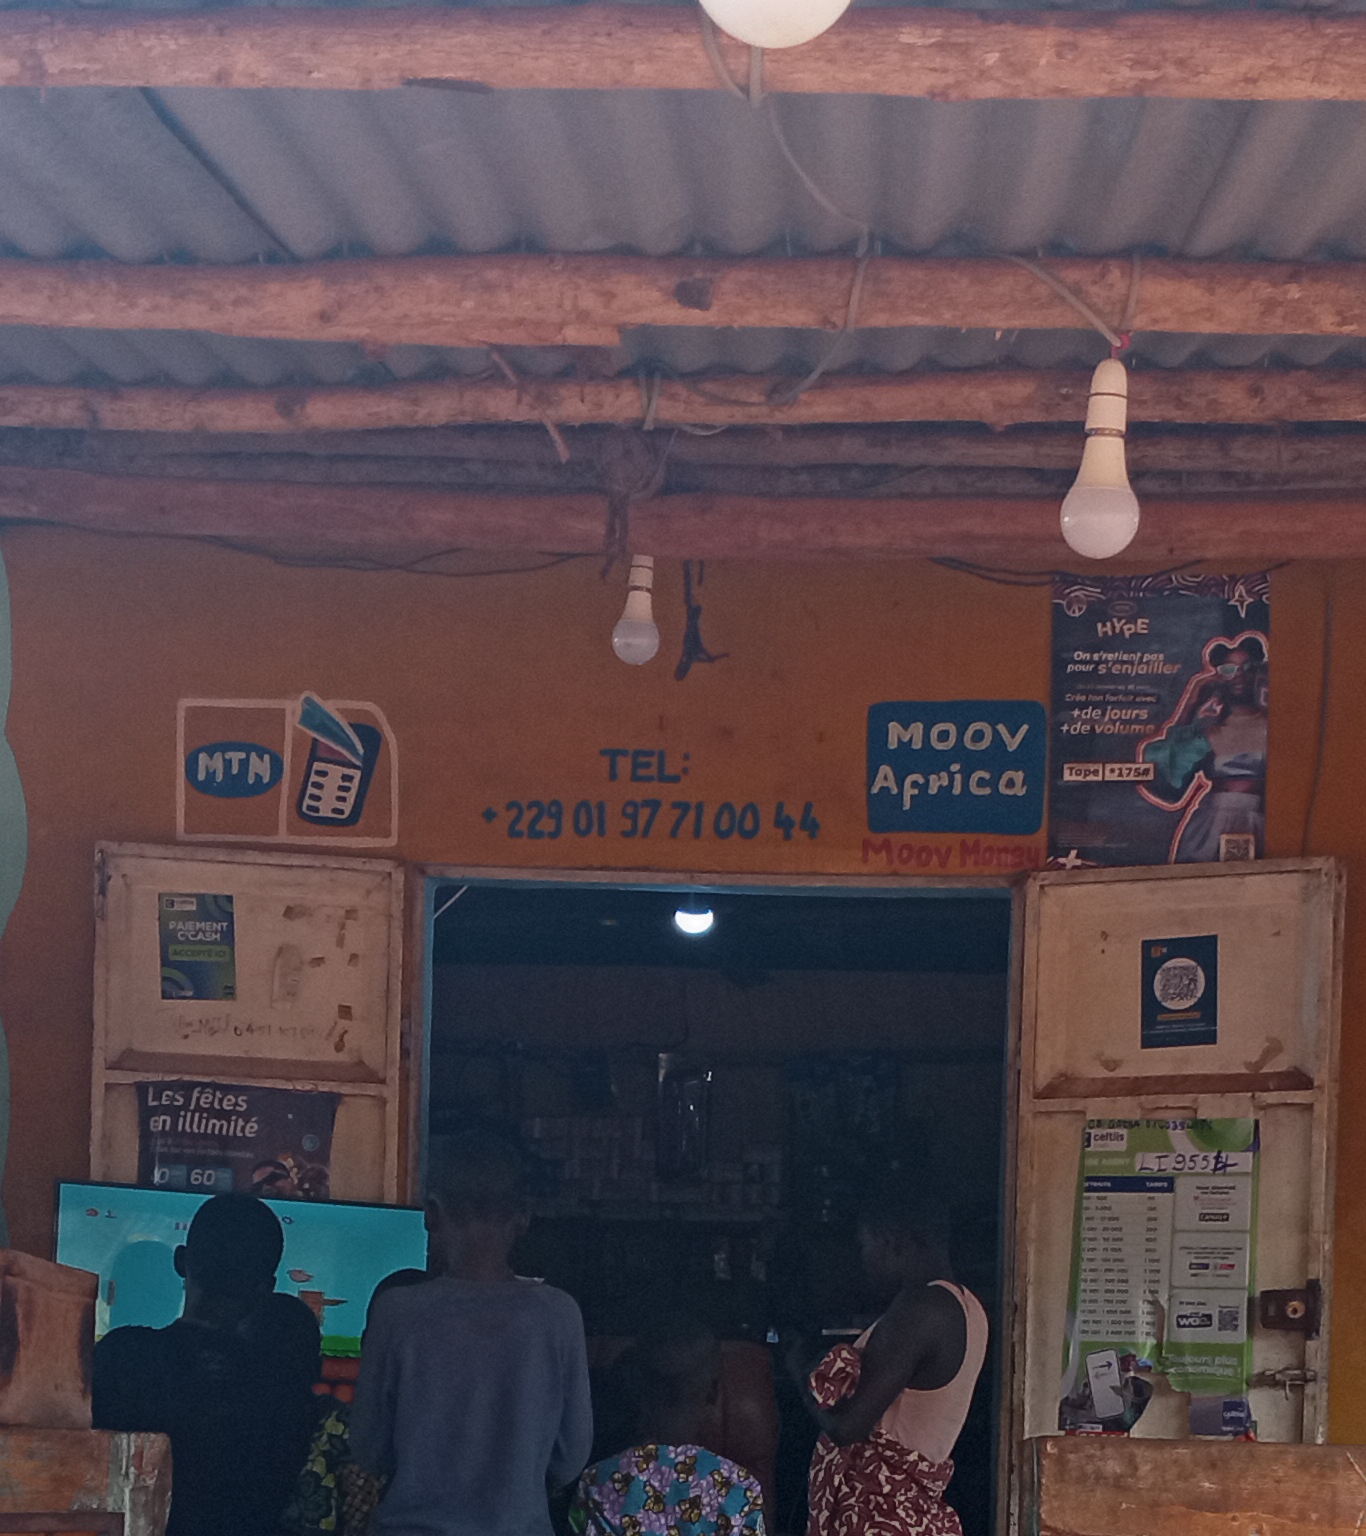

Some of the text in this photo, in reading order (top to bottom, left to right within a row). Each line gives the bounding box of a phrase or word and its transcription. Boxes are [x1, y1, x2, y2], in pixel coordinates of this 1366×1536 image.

[1074, 651, 1090, 661] On
[1066, 661, 1182, 677] pour s'enjailler
[1104, 706, 1149, 722] jours
[887, 721, 1030, 752] MOOV
[1095, 722, 1156, 735] volume
[197, 751, 271, 785] MTN
[599, 748, 690, 783] TEL:
[1066, 766, 1100, 779] Tape
[870, 763, 1027, 810] Africa
[573, 801, 606, 838] 01
[620, 799, 662, 839] 97
[670, 801, 704, 839] 71
[713, 802, 760, 840] 00
[773, 801, 820, 840] 44
[861, 838, 952, 869] Moov
[168, 921, 229, 932] PAIEMENT
[147, 1086, 248, 1111] Les fêtes
[177, 1111, 259, 1137] illimité
[190, 1168, 216, 1185] 60
